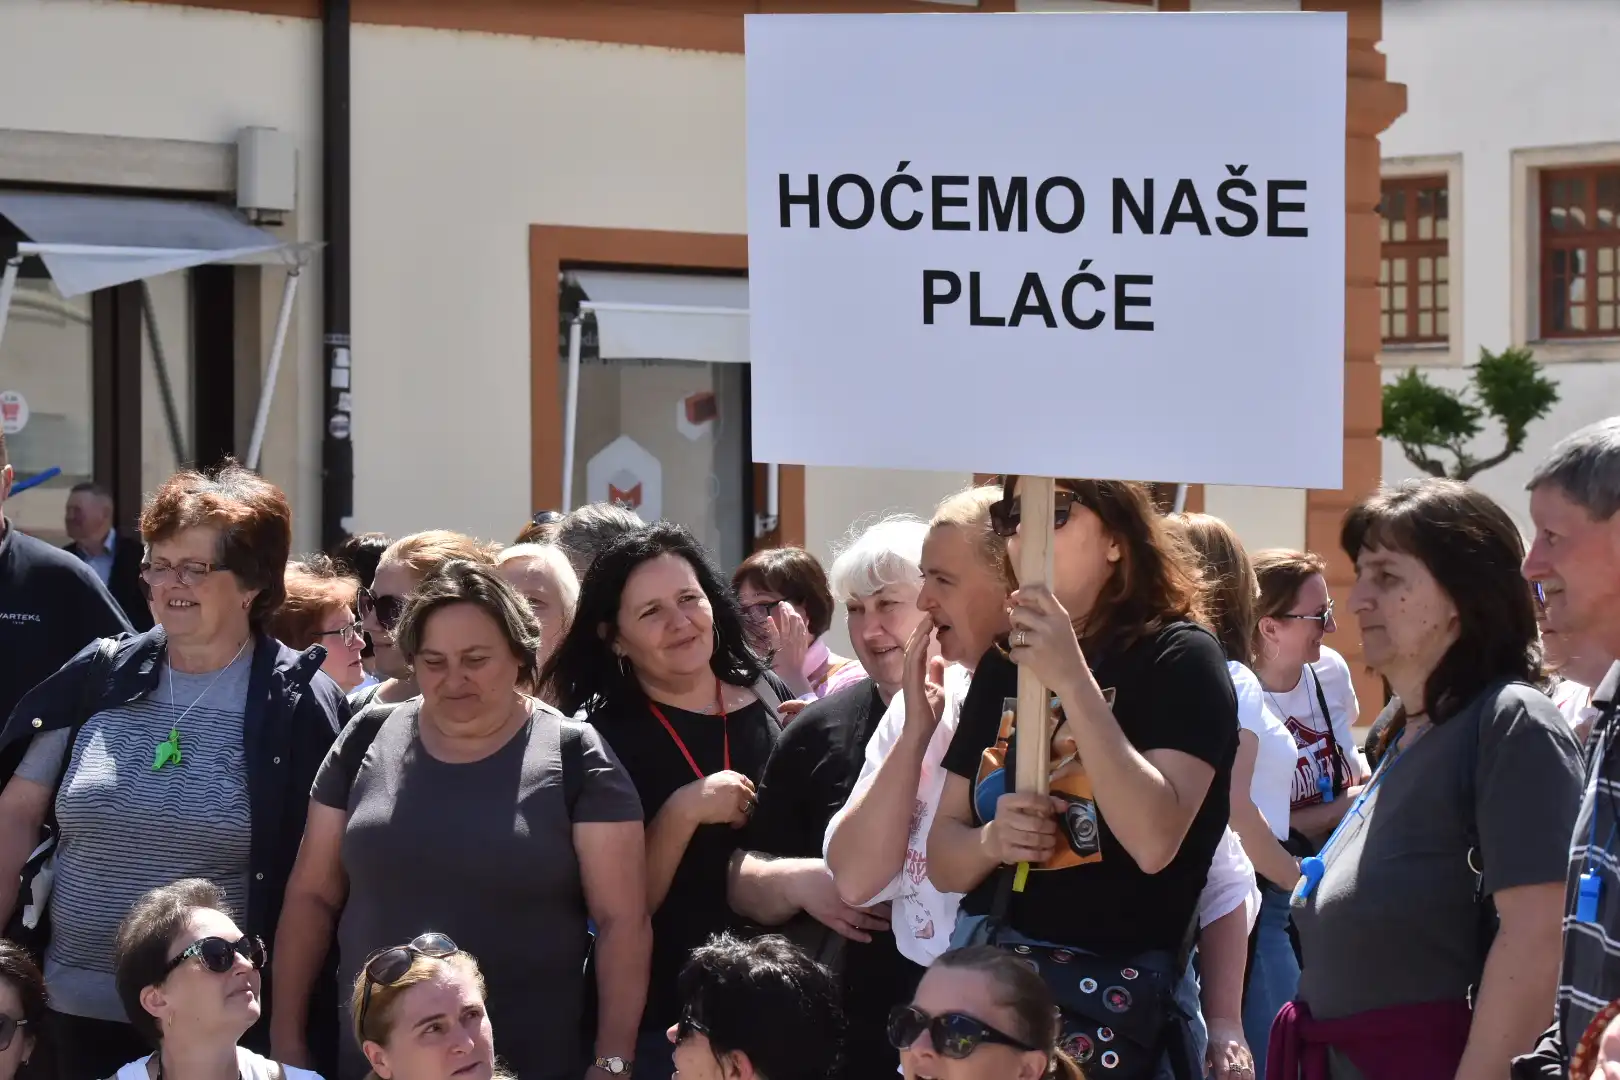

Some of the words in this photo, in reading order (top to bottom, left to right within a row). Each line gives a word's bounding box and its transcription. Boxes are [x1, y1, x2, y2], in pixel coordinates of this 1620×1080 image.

[778, 160, 1085, 234] HOĆEMO
[1112, 164, 1309, 238] NAŠE
[922, 259, 1155, 332] PLAĆE
